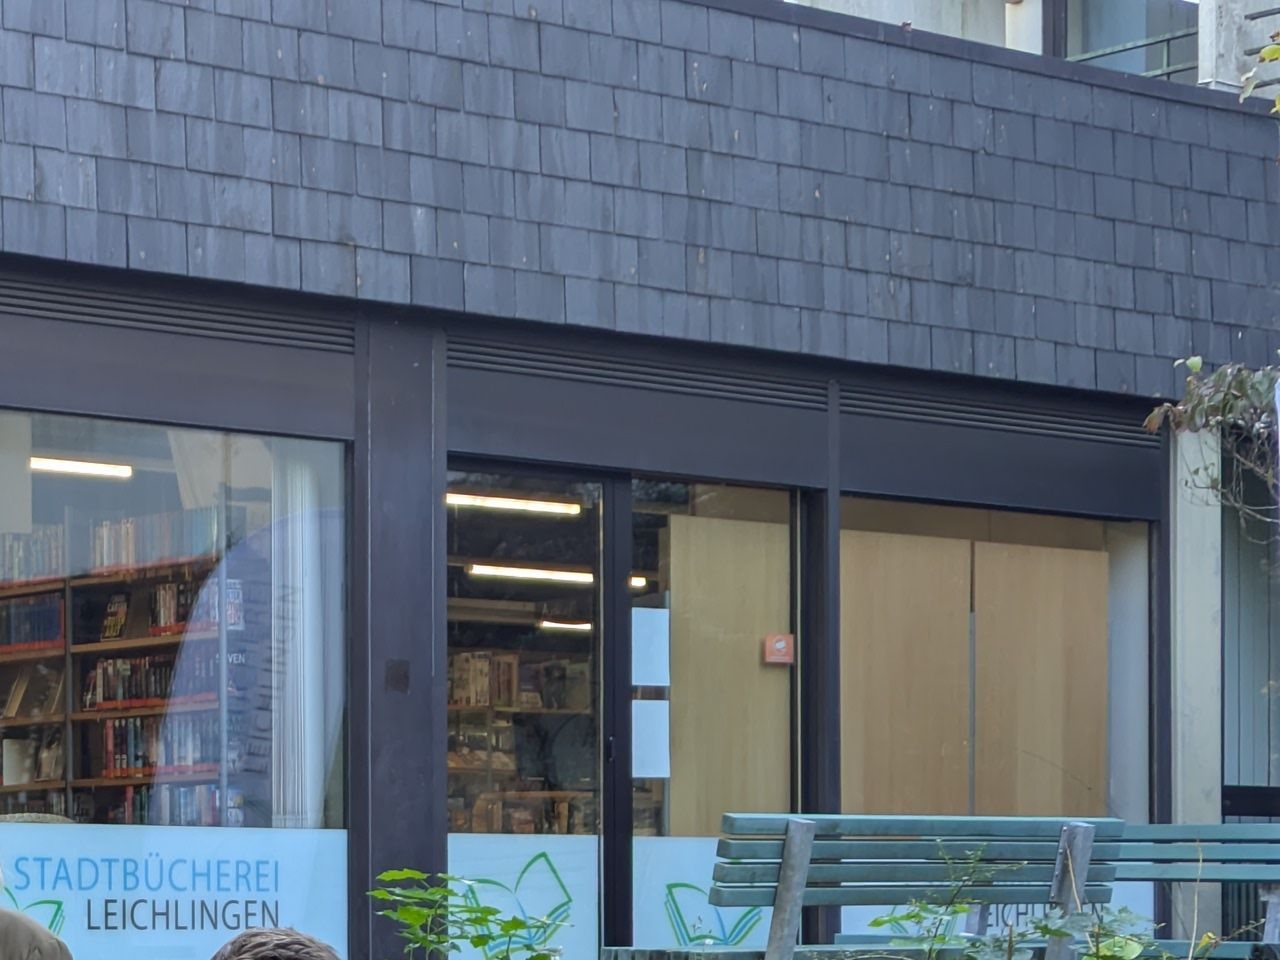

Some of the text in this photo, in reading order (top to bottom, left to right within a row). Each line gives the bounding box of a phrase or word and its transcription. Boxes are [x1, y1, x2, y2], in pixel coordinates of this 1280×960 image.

[215, 653, 246, 664] SVEN
[14, 852, 279, 893] STADTBÜCHEREI
[87, 898, 279, 931] LEICHLINGEN
